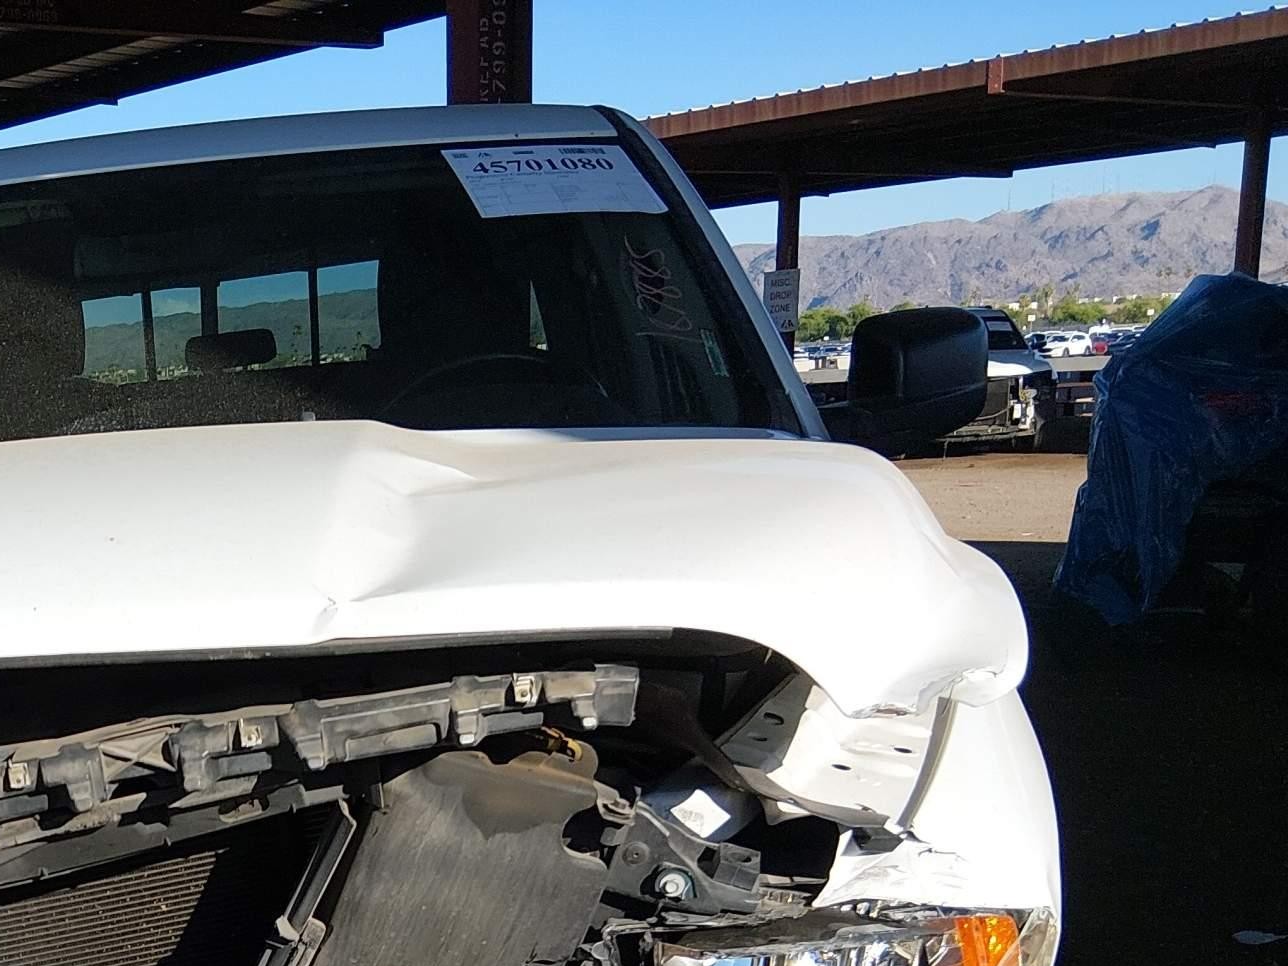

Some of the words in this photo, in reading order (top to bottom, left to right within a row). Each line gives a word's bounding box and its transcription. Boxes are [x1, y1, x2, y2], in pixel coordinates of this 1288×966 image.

[472, 157, 614, 175] 45701080
[770, 291, 792, 300] DROP
[769, 304, 791, 313] ZONE
